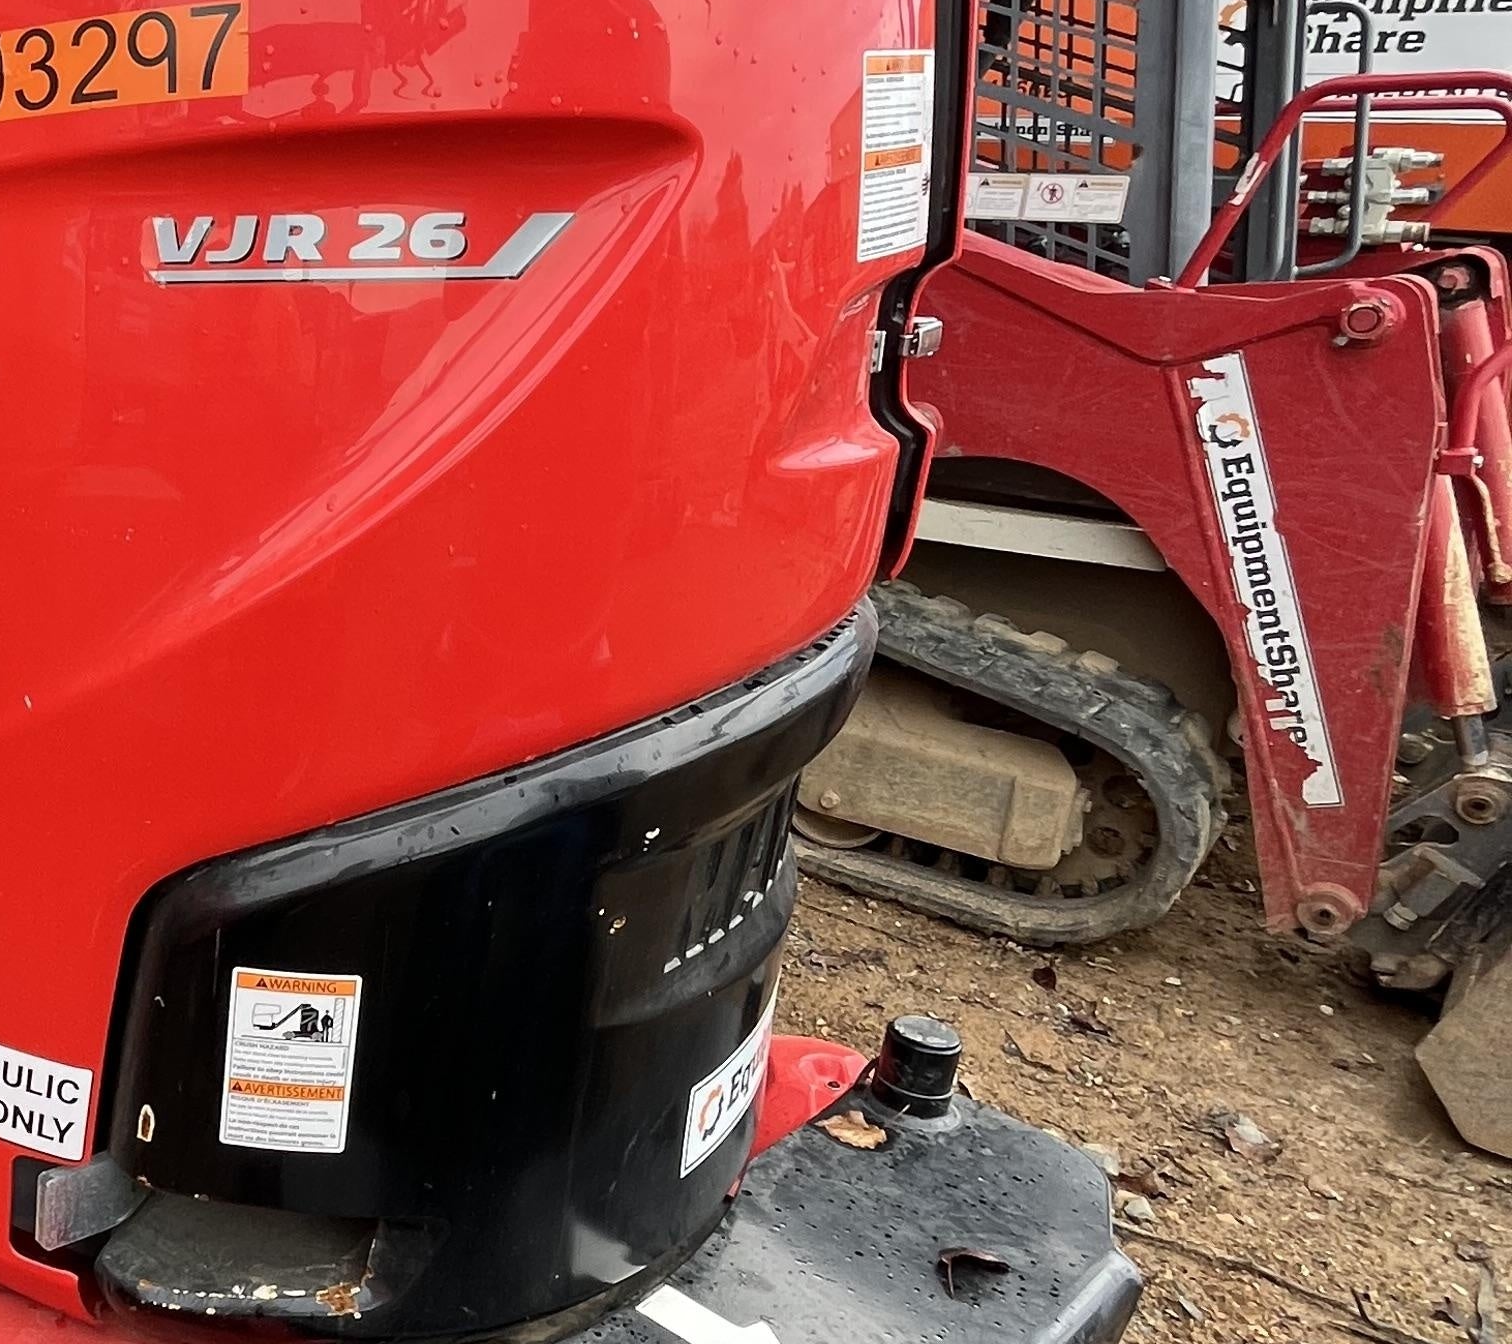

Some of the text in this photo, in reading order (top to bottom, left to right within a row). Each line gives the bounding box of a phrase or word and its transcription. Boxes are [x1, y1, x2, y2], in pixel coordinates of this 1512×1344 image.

[1306, 25, 1426, 53] hare
[152, 212, 467, 264] VJR 26
[1221, 453, 1309, 744] EquipmentShare
[269, 977, 337, 994] WARNING
[244, 1081, 343, 1099] AVERTISSEMENT
